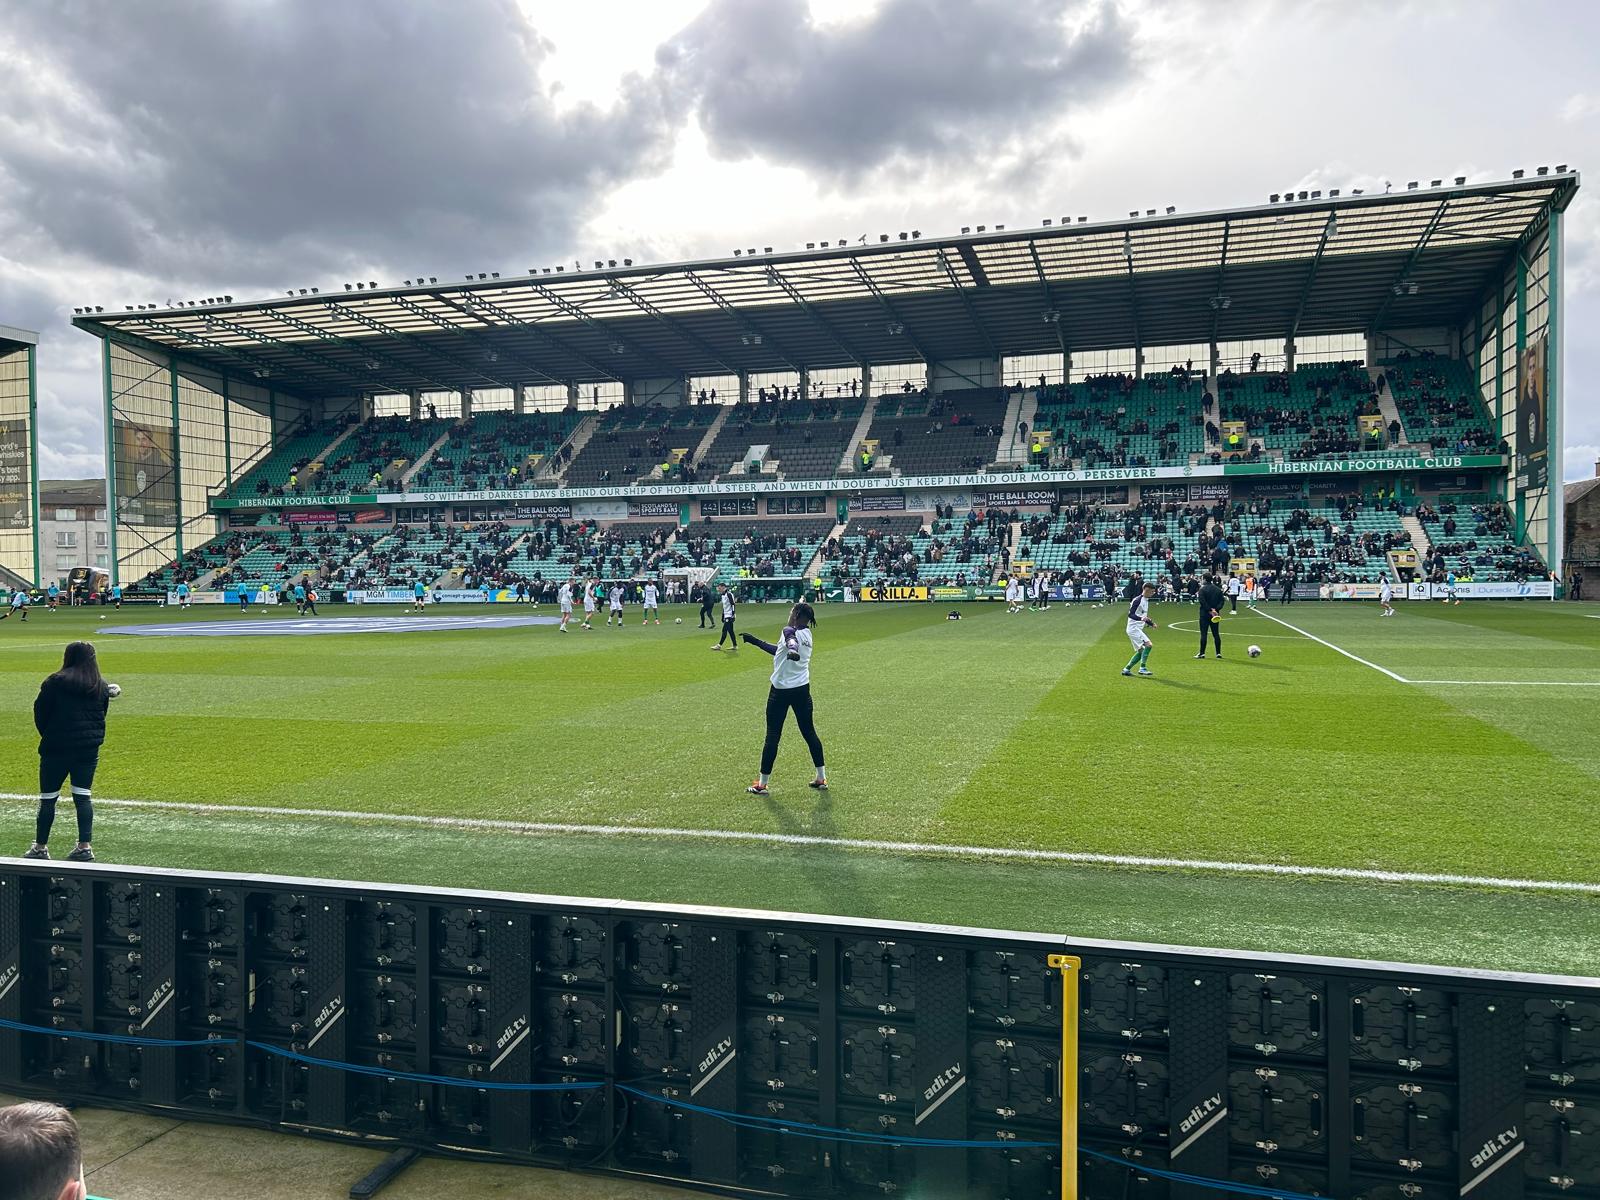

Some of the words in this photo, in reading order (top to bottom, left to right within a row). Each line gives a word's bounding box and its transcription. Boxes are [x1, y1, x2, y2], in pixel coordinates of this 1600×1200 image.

[884, 479, 912, 487] JUST
[966, 476, 996, 484] MIND
[1085, 469, 1156, 479] PERSEVERE
[1270, 461, 1342, 472] HIBERNIAN
[1348, 458, 1420, 470] FOOTBALL
[1424, 457, 1462, 468] CLUB
[239, 498, 282, 506] HIBERNIAN
[146, 977, 173, 1009] adi.tv
[314, 994, 342, 1028] adi.tv
[497, 1014, 528, 1049] adi.tv
[699, 1036, 732, 1073] adi.tv
[924, 1062, 961, 1100] adi.tv
[1180, 1092, 1222, 1133] adi.tv
[1470, 1126, 1518, 1168] adi.tv
